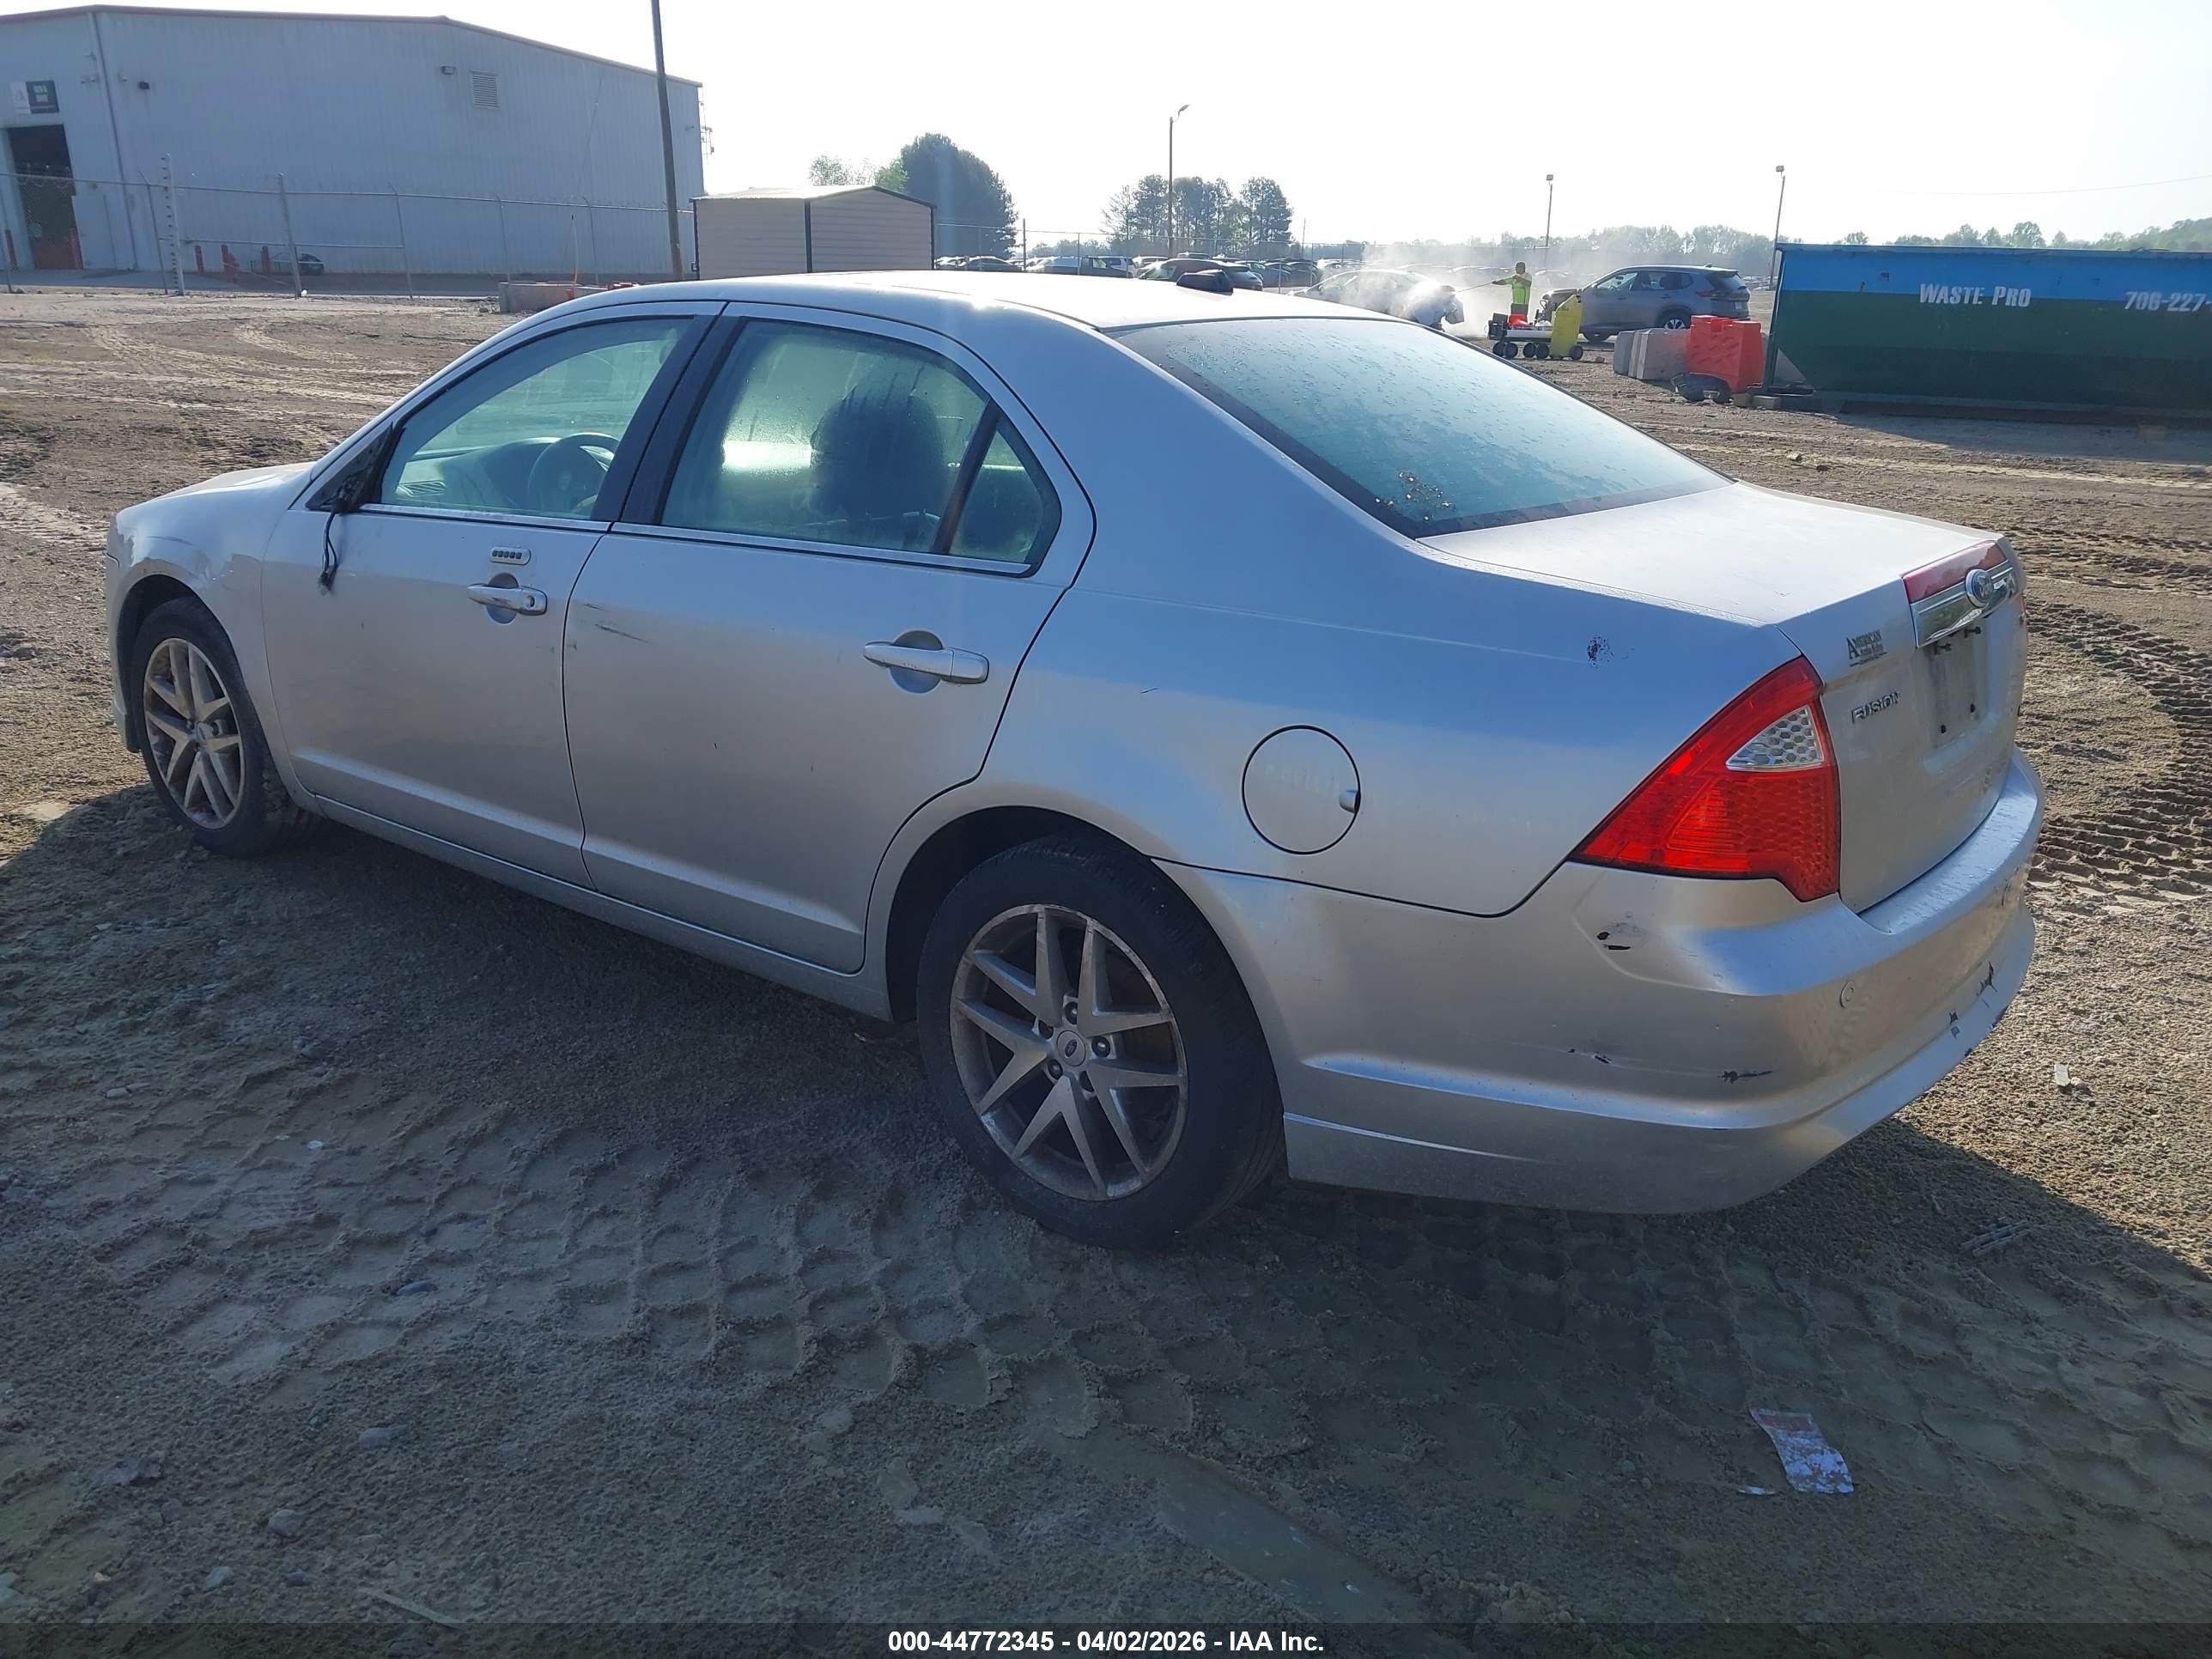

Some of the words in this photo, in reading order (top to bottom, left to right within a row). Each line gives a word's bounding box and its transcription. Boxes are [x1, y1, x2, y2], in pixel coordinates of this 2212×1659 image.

[1919, 283, 1985, 305] WASTE
[1991, 285, 2032, 307] PRO
[1850, 690, 1901, 722] FUSION
